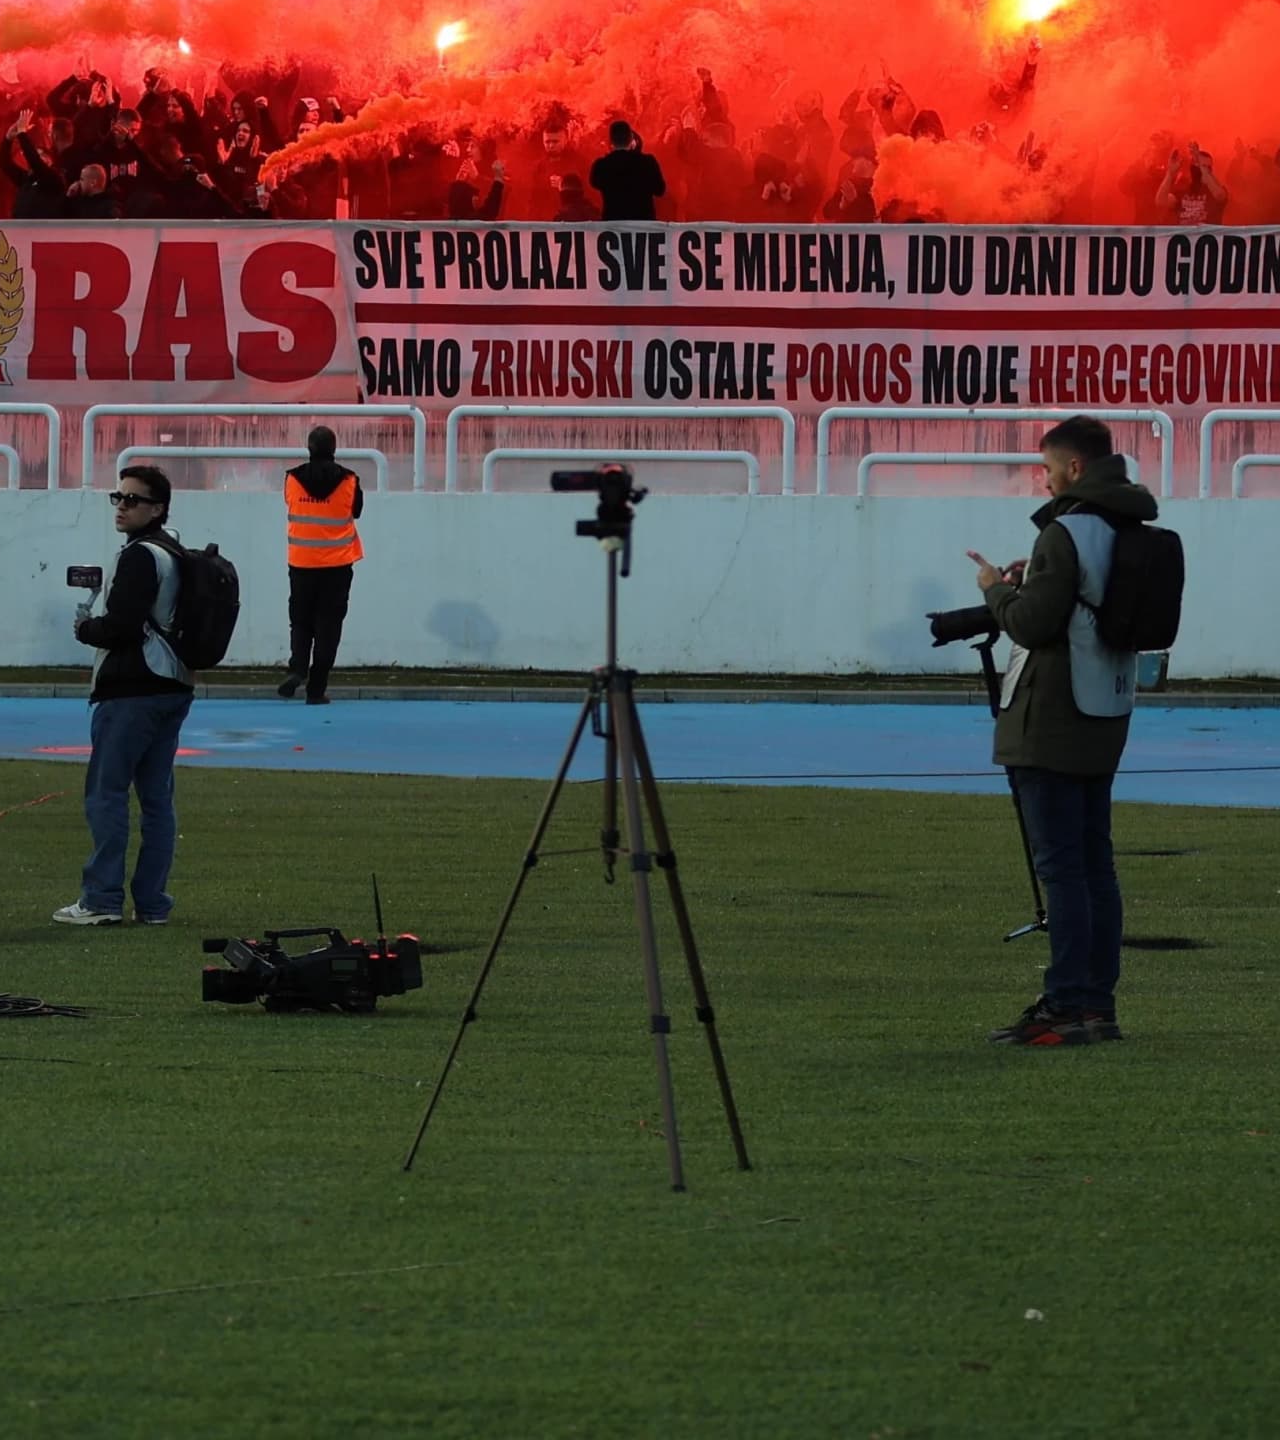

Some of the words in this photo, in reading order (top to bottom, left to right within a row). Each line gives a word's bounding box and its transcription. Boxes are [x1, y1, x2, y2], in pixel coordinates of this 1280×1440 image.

[353, 229, 425, 290] SVE
[432, 230, 588, 291] PROLAZI
[597, 230, 668, 292] SVE
[678, 230, 724, 292] SE
[733, 232, 897, 300] MIJENJA,
[906, 234, 974, 296] IDU
[984, 235, 1077, 297] DANI
[1088, 234, 1155, 297] IDU
[357, 337, 461, 398] SAMO
[470, 338, 634, 399] ZRINJSKI
[643, 338, 776, 400] OSTAJE
[786, 342, 912, 404] PONOS
[922, 344, 1019, 405] MOJE
